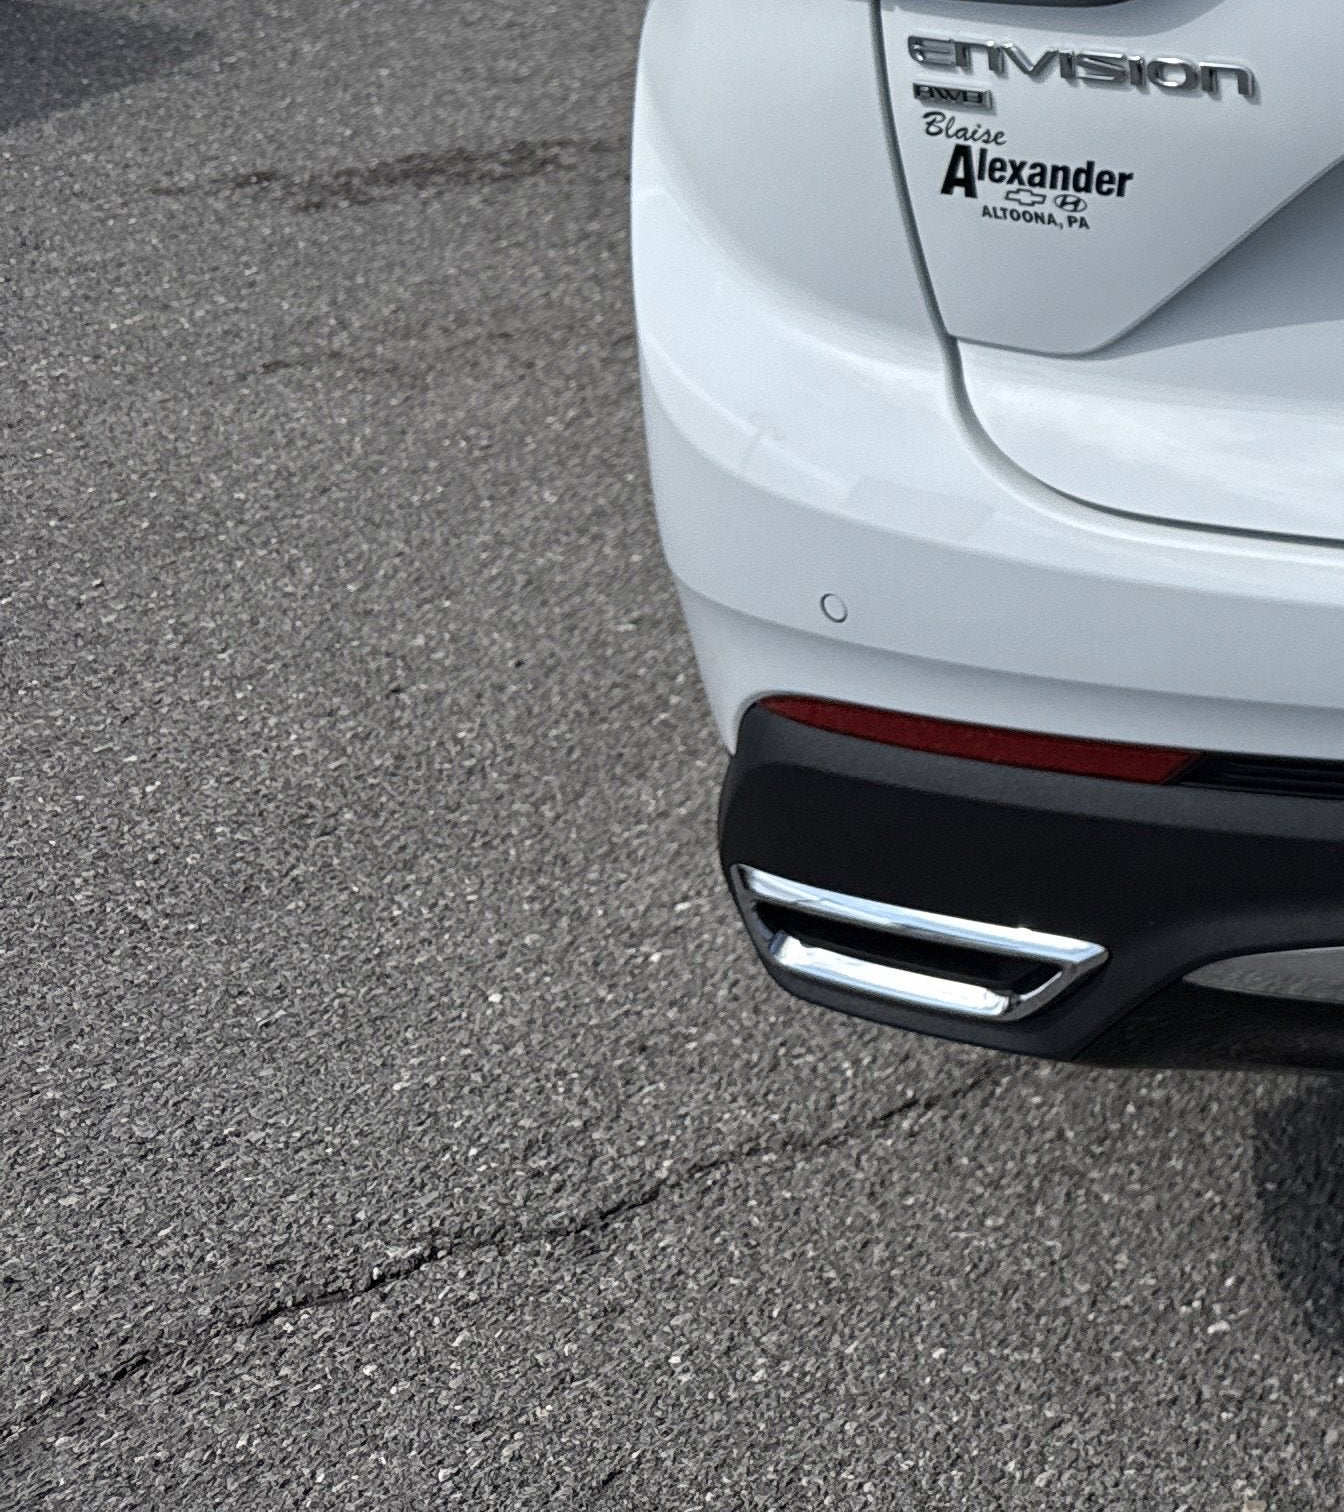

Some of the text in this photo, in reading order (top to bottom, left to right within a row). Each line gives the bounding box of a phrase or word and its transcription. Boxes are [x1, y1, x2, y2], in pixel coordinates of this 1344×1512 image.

[907, 35, 1258, 96] ENVISION
[921, 110, 1008, 147] Blaise
[940, 143, 1135, 198] Alexander
[981, 204, 1091, 230] ALTOONA, PA
